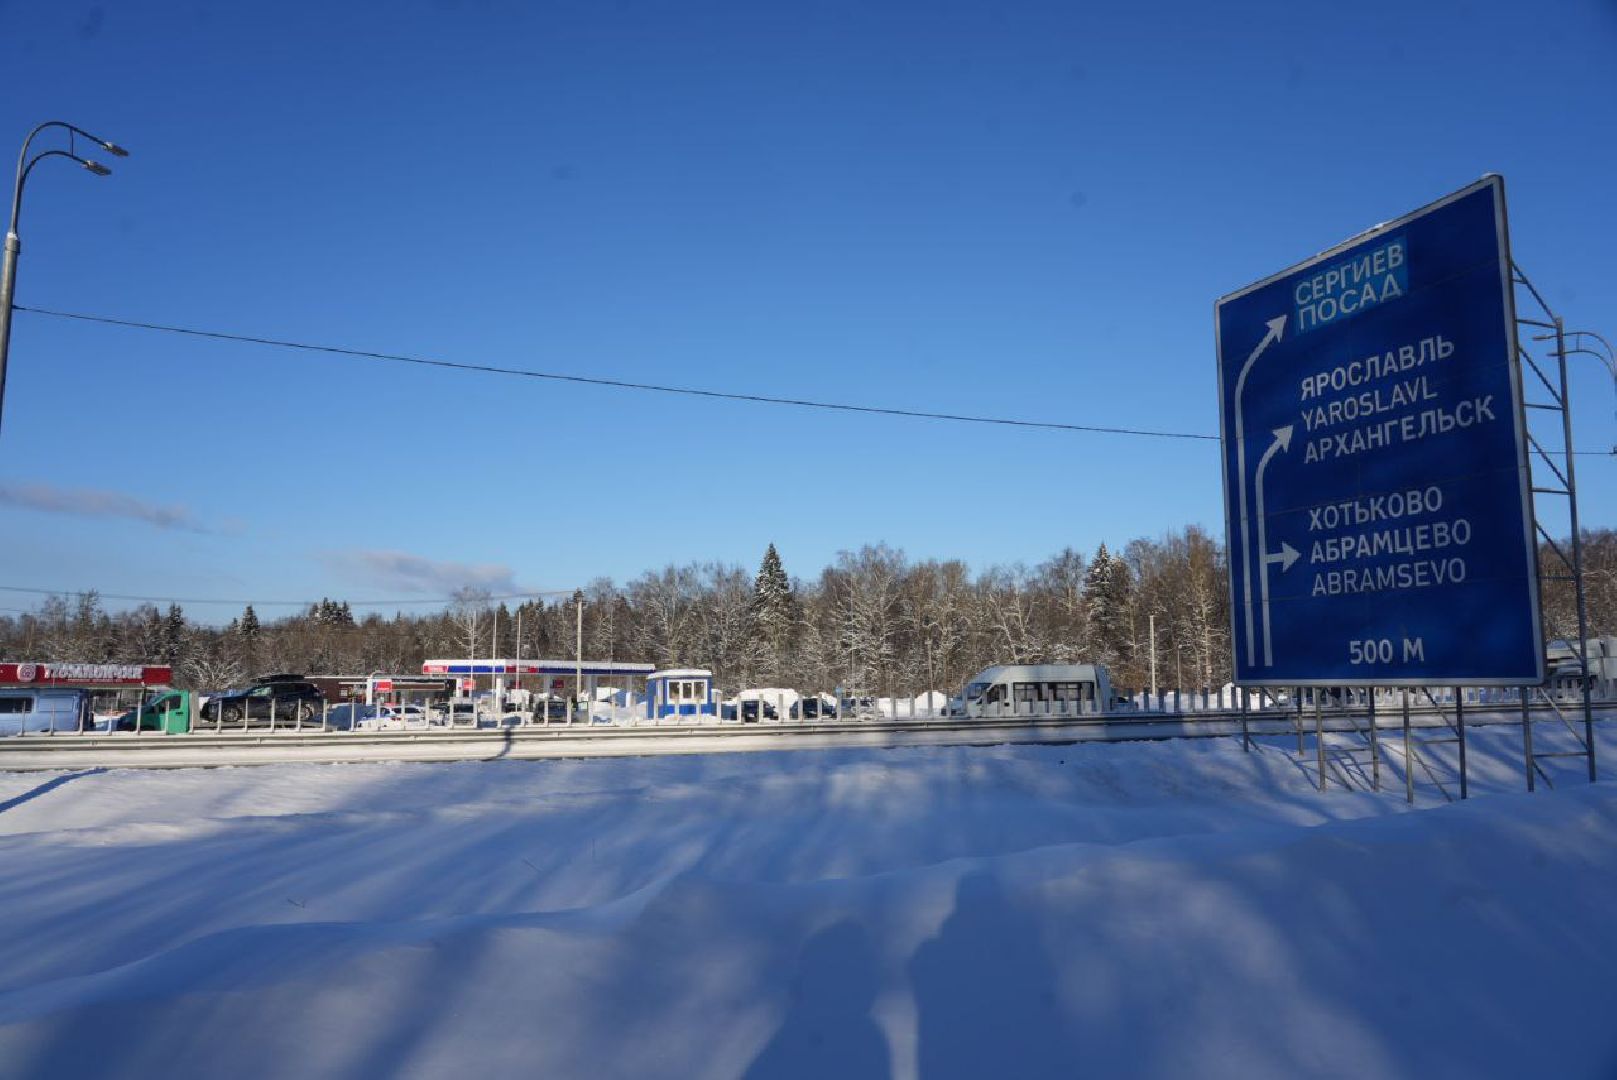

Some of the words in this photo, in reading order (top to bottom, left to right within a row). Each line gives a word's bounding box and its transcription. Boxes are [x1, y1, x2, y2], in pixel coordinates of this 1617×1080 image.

[1296, 244, 1404, 305] СЕРГИЕВ
[1299, 275, 1402, 330] ПОСАД
[1301, 336, 1454, 399] ЯРОСЛАВЛЬ
[1302, 376, 1437, 430] YAROSLAVL
[1304, 395, 1494, 463] АРХАНГЕЛЬСК
[1309, 486, 1442, 530] ХОТЬКОВО
[1311, 519, 1470, 562] АБРАМЦЕВО
[1312, 558, 1466, 596] ABRAMSEVO
[1350, 640, 1393, 664] 500
